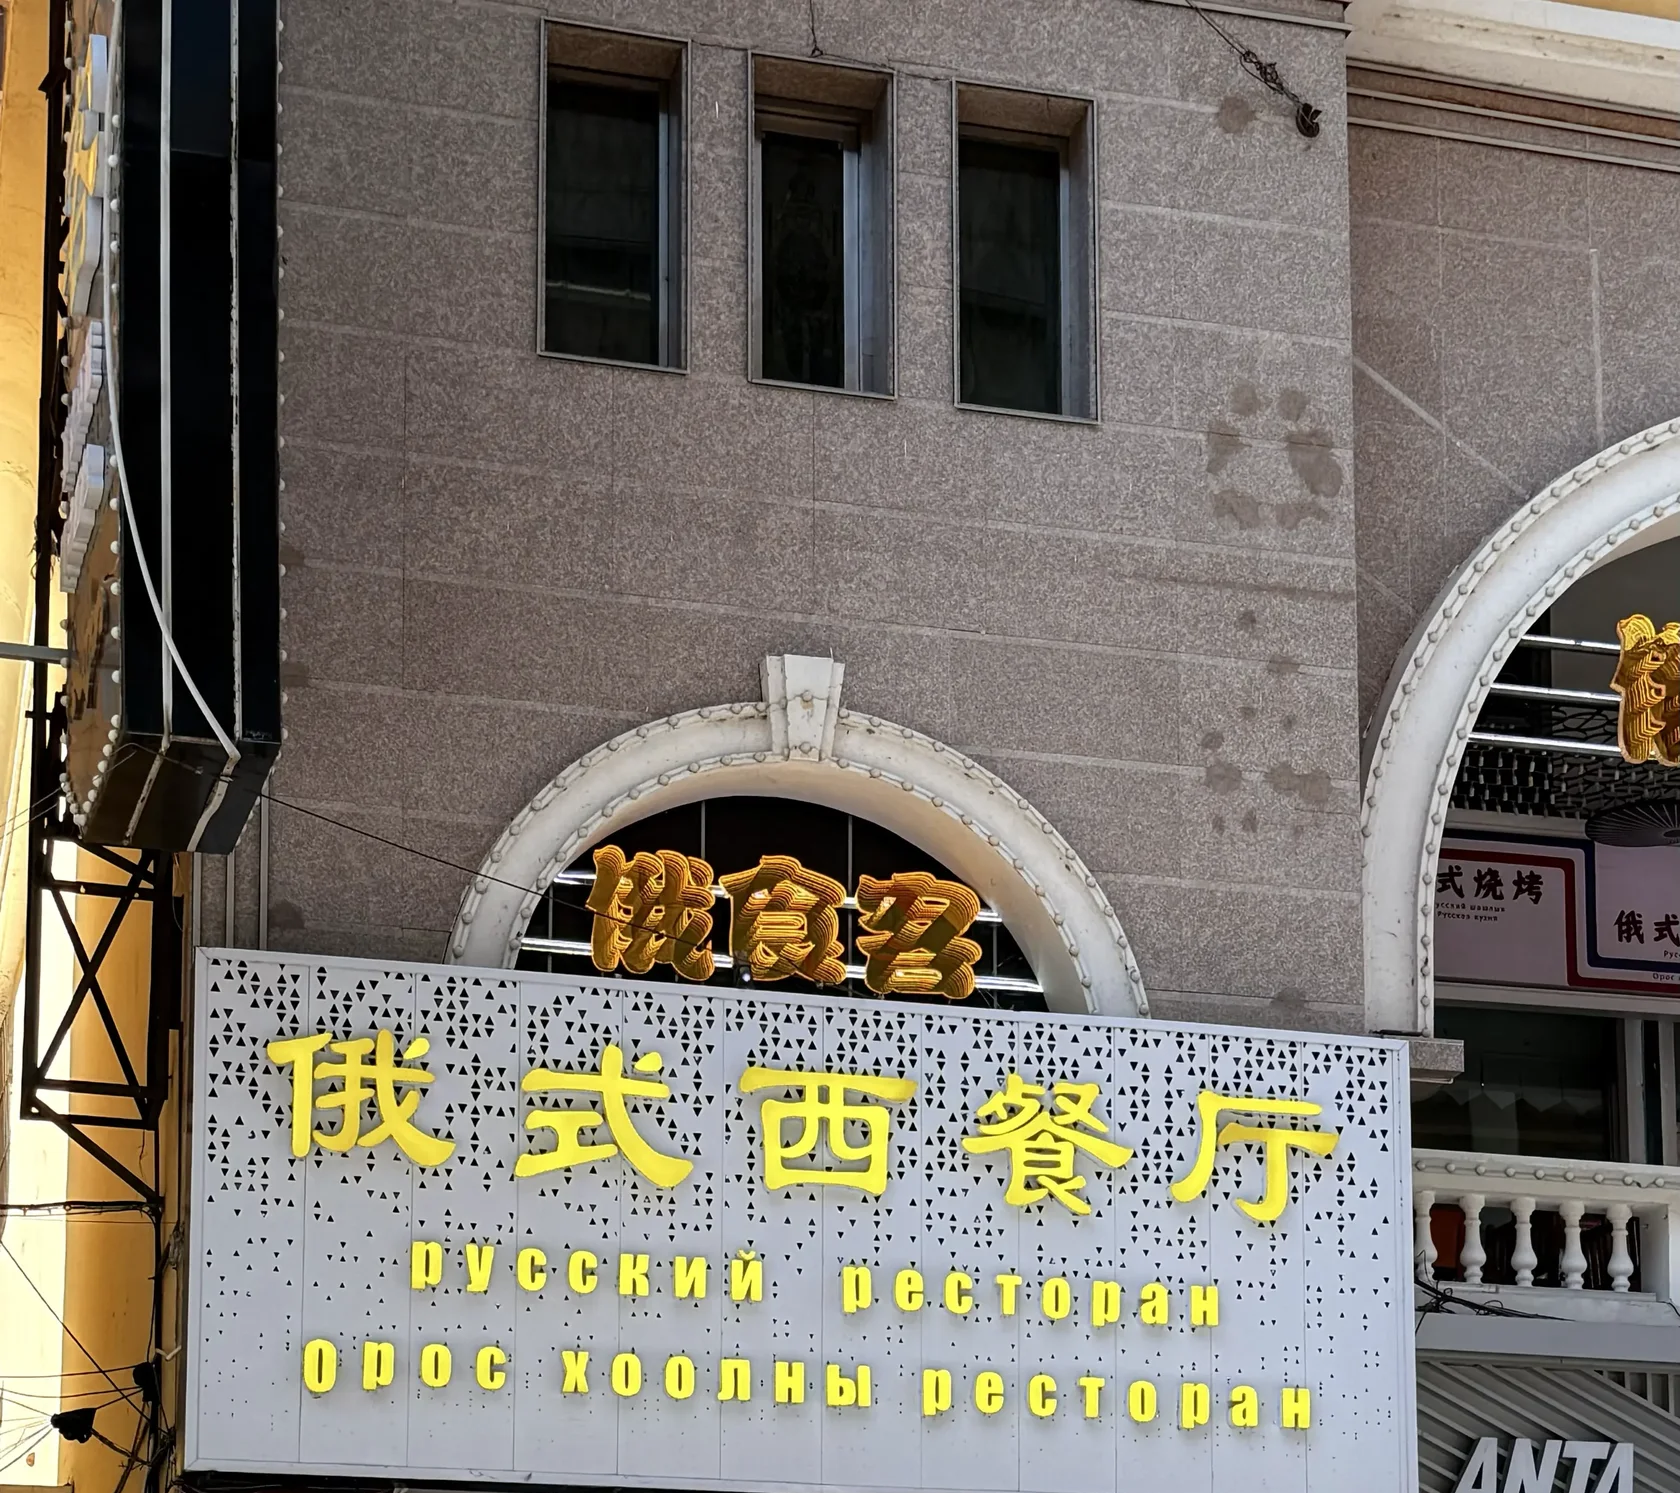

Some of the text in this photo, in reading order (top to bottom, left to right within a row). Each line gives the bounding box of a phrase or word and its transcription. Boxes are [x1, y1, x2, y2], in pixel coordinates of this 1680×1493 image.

[1663, 949, 1680, 960] Рус
[267, 1028, 1338, 1224] 俄式西餐厅
[410, 1239, 1220, 1328] русский ресторан
[561, 1351, 872, 1410] хоолны
[922, 1367, 1316, 1432] ресторан
